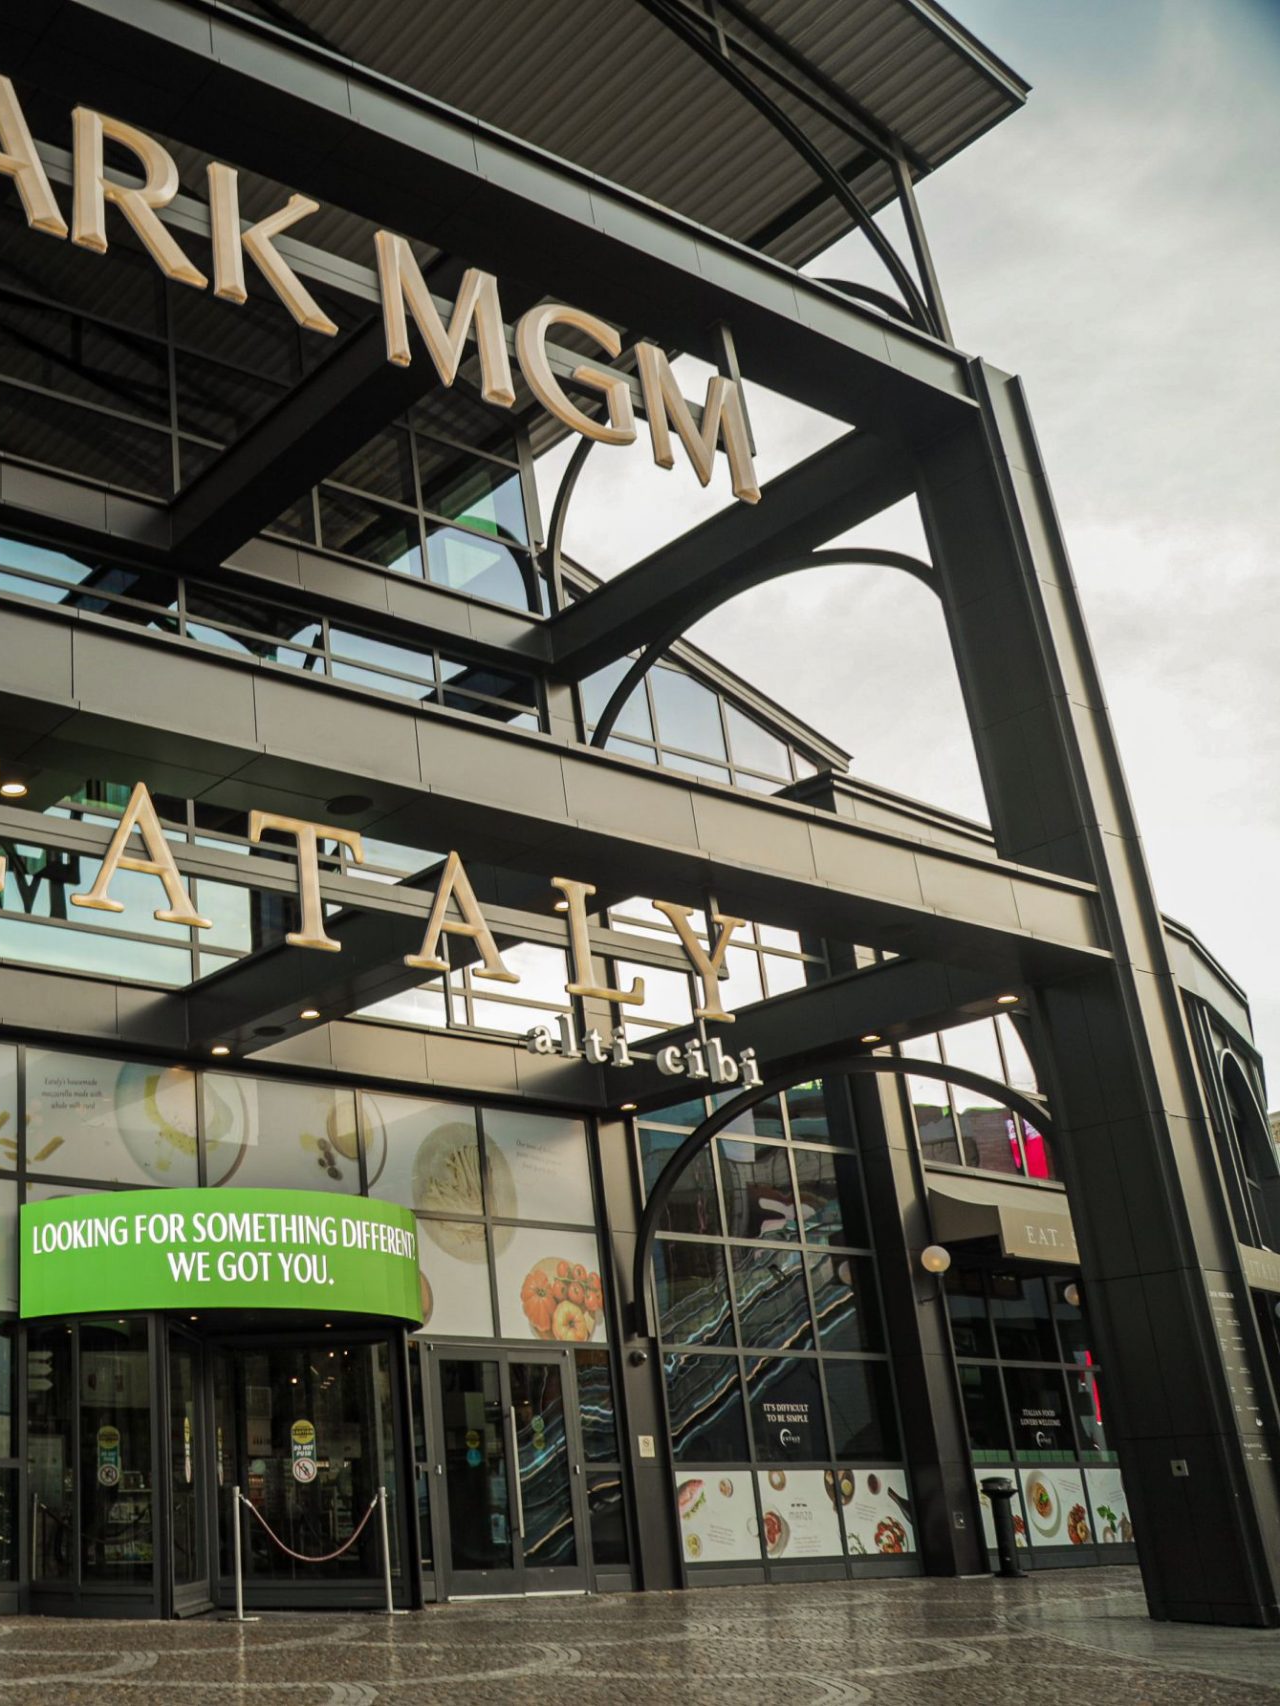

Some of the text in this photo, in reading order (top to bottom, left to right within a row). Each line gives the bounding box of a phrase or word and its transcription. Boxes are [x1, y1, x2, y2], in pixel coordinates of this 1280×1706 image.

[373, 230, 761, 504] MGM
[527, 1013, 763, 1089] alti cibi
[32, 1212, 416, 1261] LOOKING FOR SOMETHING DIFFERENT?
[167, 1251, 334, 1286] WE GOT YOU.
[776, 1404, 808, 1412] DIFFICULT
[786, 1414, 808, 1423] SIMPLE
